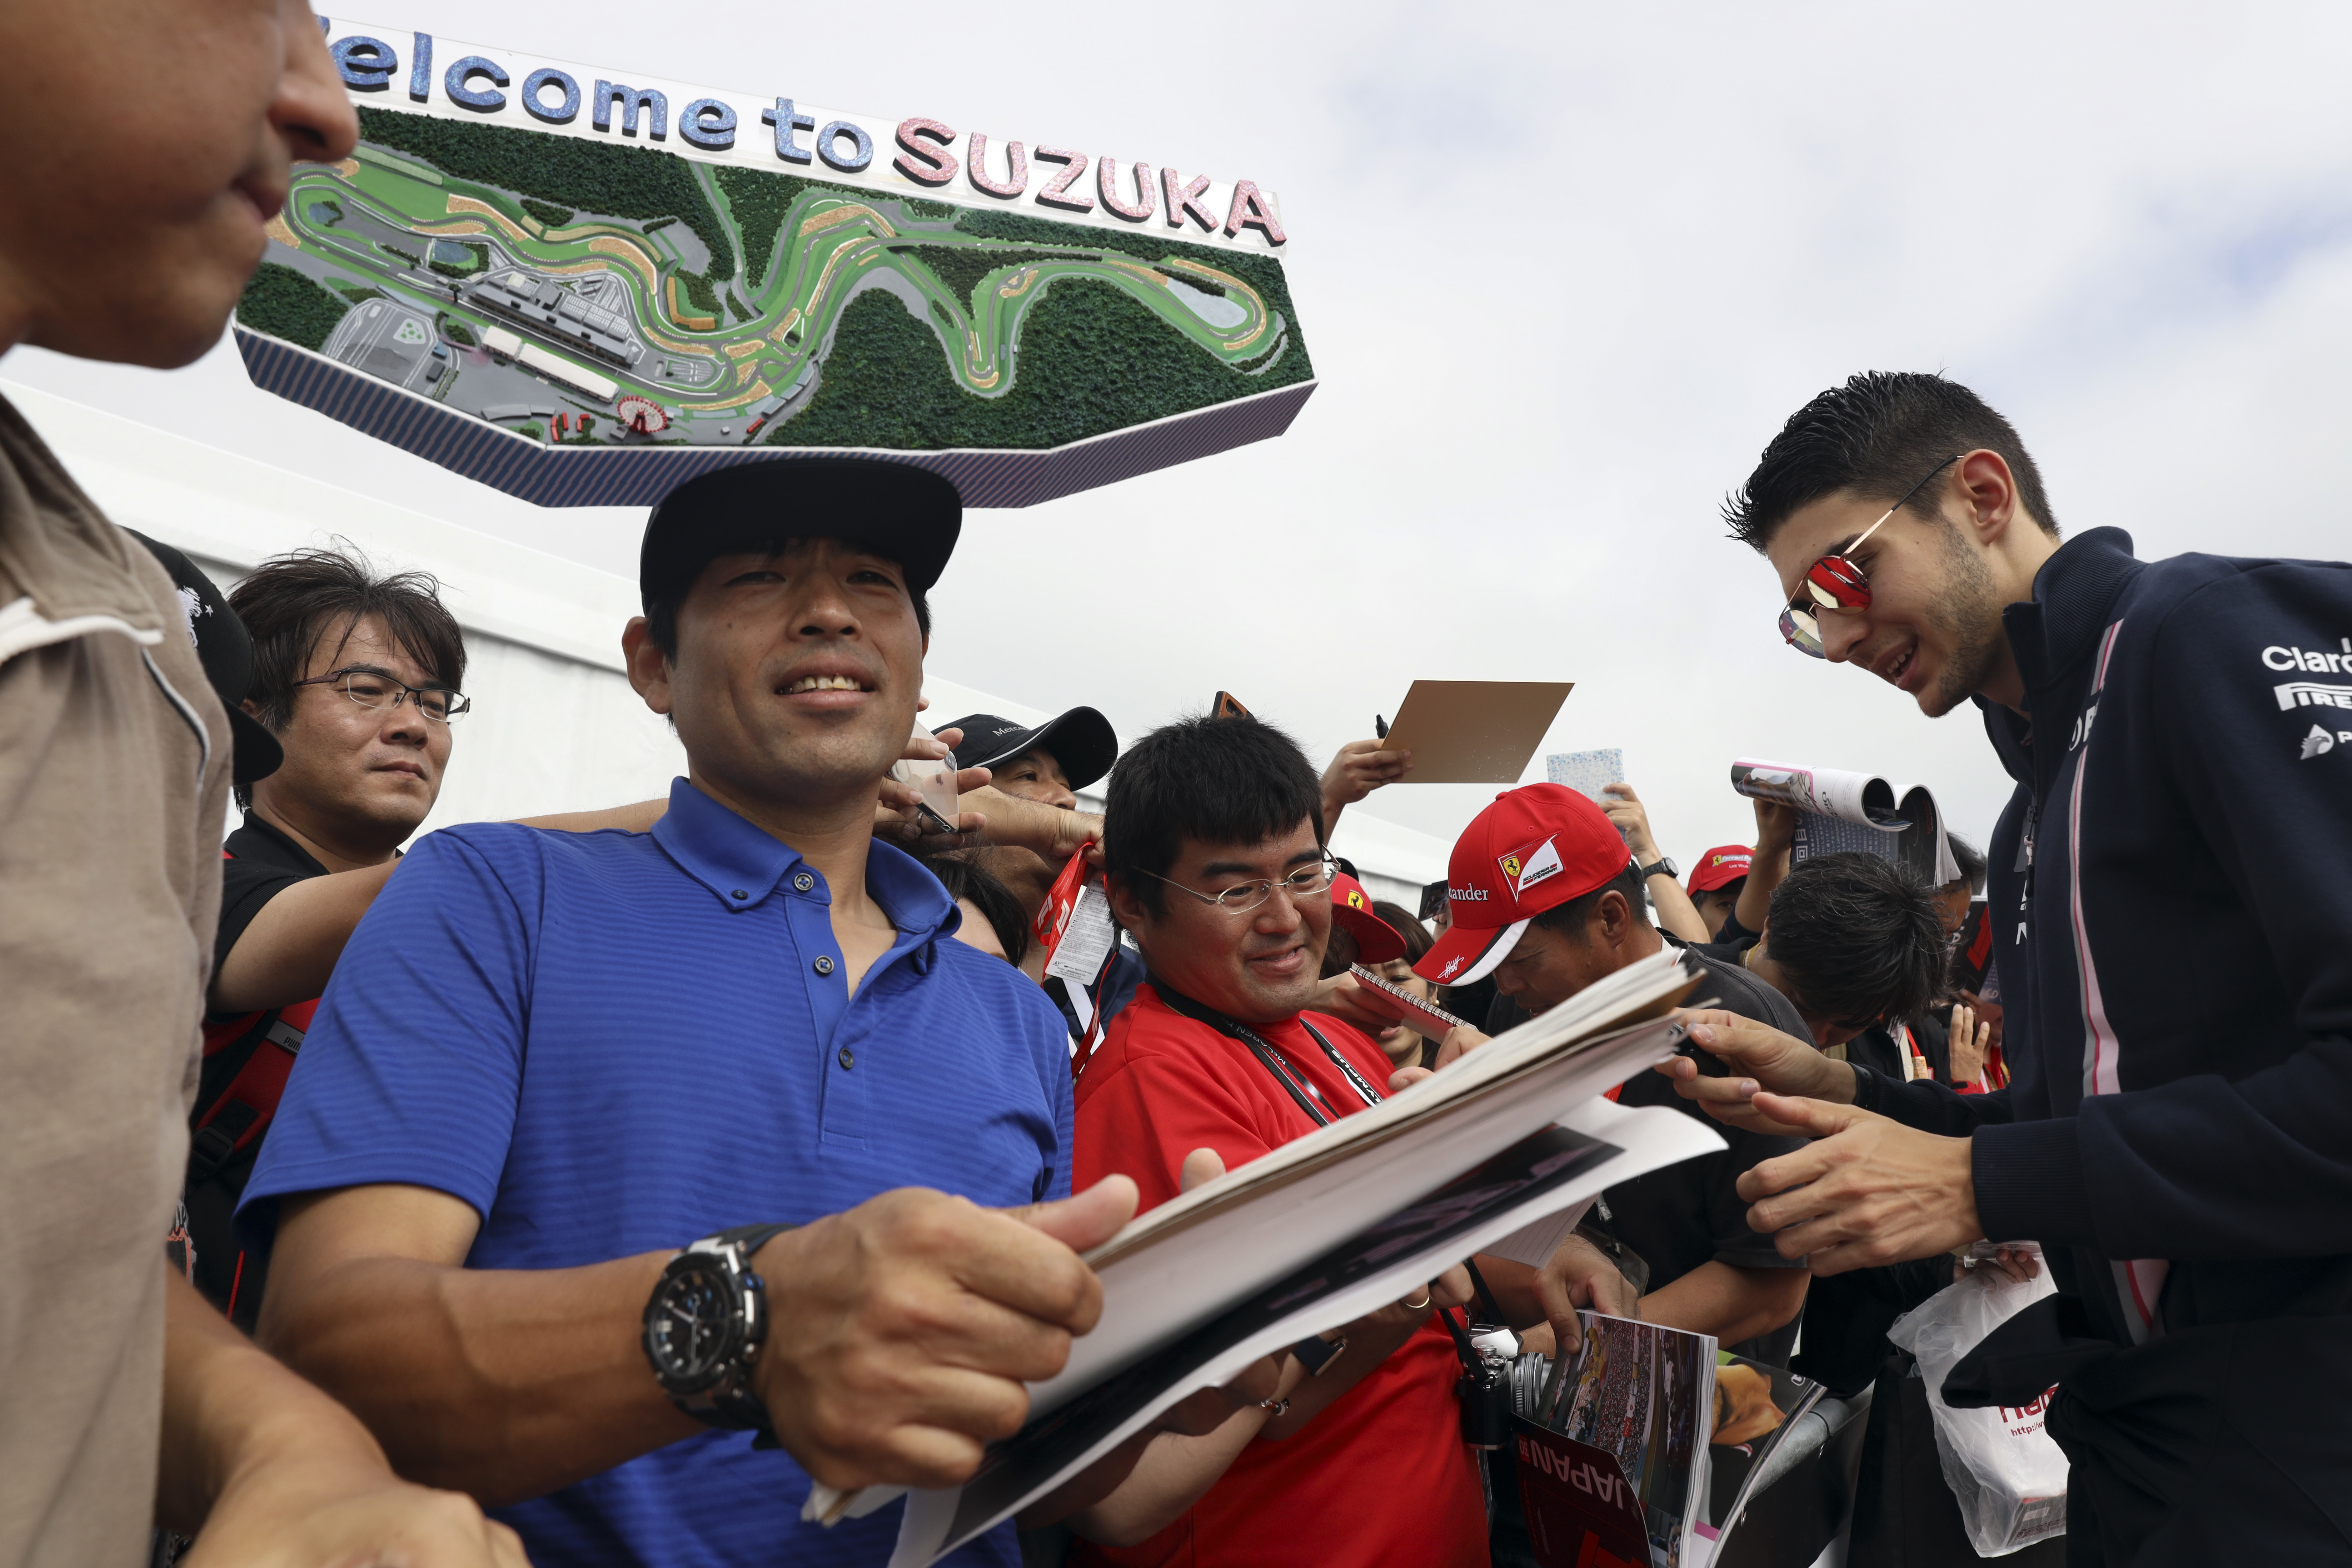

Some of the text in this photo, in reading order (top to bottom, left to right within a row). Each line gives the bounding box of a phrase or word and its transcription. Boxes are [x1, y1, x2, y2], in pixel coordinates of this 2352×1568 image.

[316, 15, 1286, 247] elcome to SUZUKA
[1523, 867, 1550, 882] SCUDERIA
[1534, 866, 1558, 880] FERRARI
[283, 1036, 302, 1051] PUM
[1236, 1025, 1286, 1065] McLAREN
[1331, 1049, 1384, 1105] LYMPUS
[1530, 1439, 1626, 1510] JAPAN
